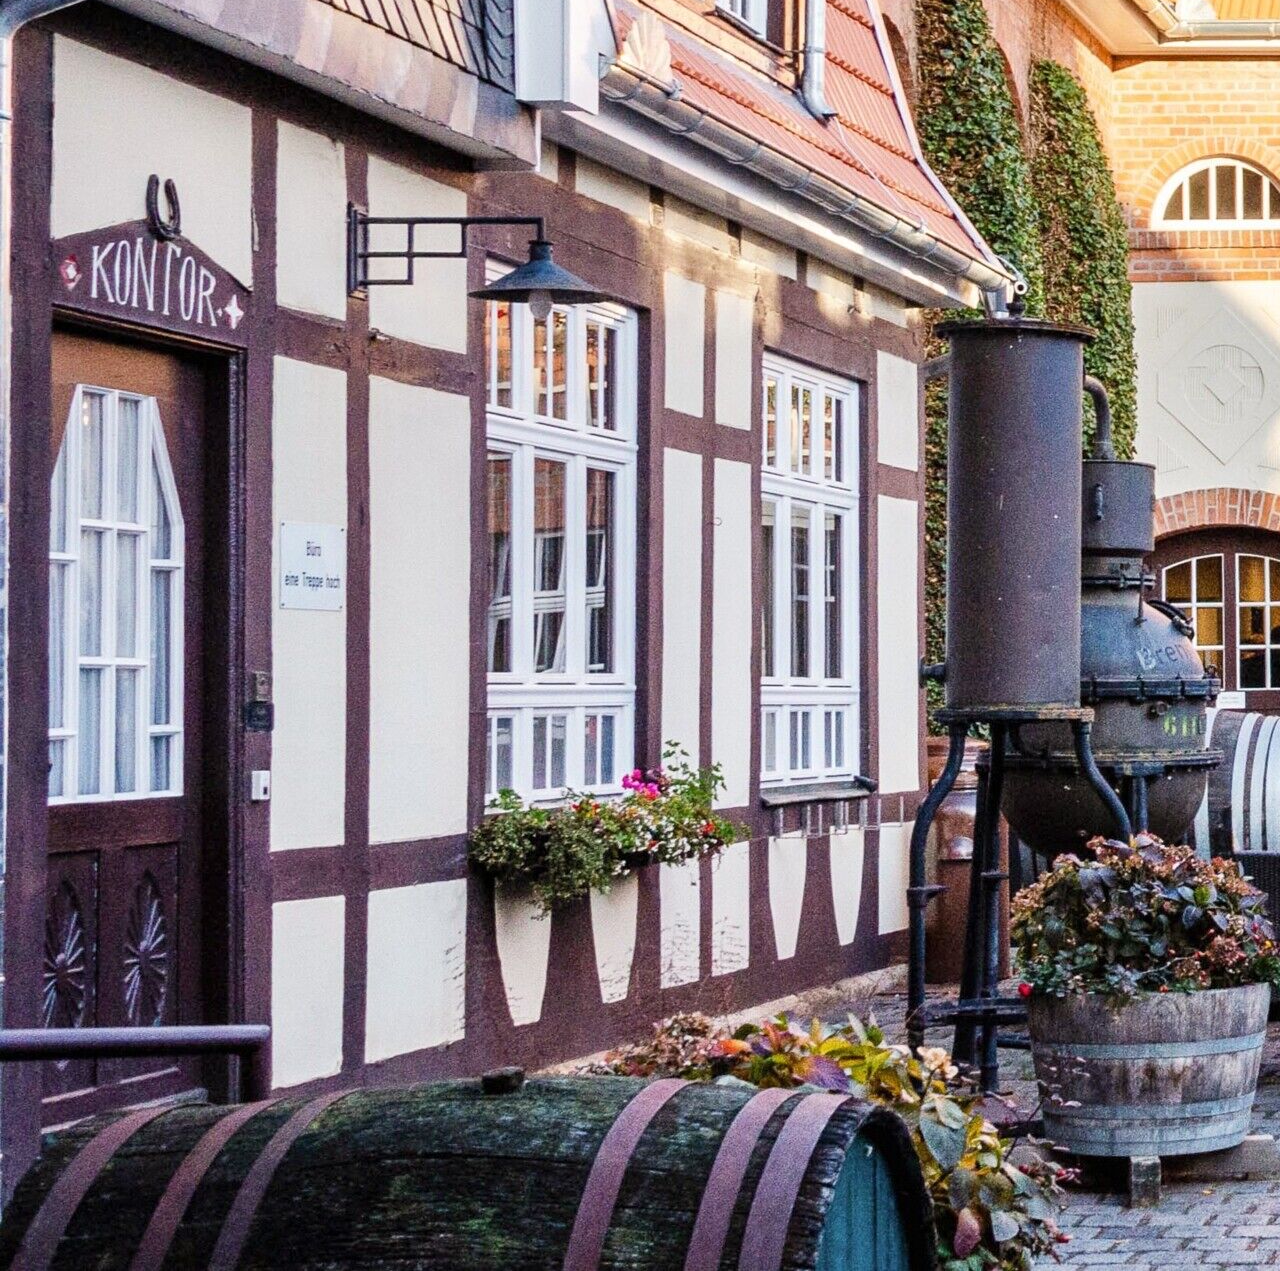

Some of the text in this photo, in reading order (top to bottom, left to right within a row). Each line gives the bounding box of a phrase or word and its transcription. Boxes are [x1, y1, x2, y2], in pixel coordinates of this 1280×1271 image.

[90, 237, 217, 327] KONTOR
[306, 540, 322, 557] Büro
[285, 571, 341, 591] eine Treppe hoch
